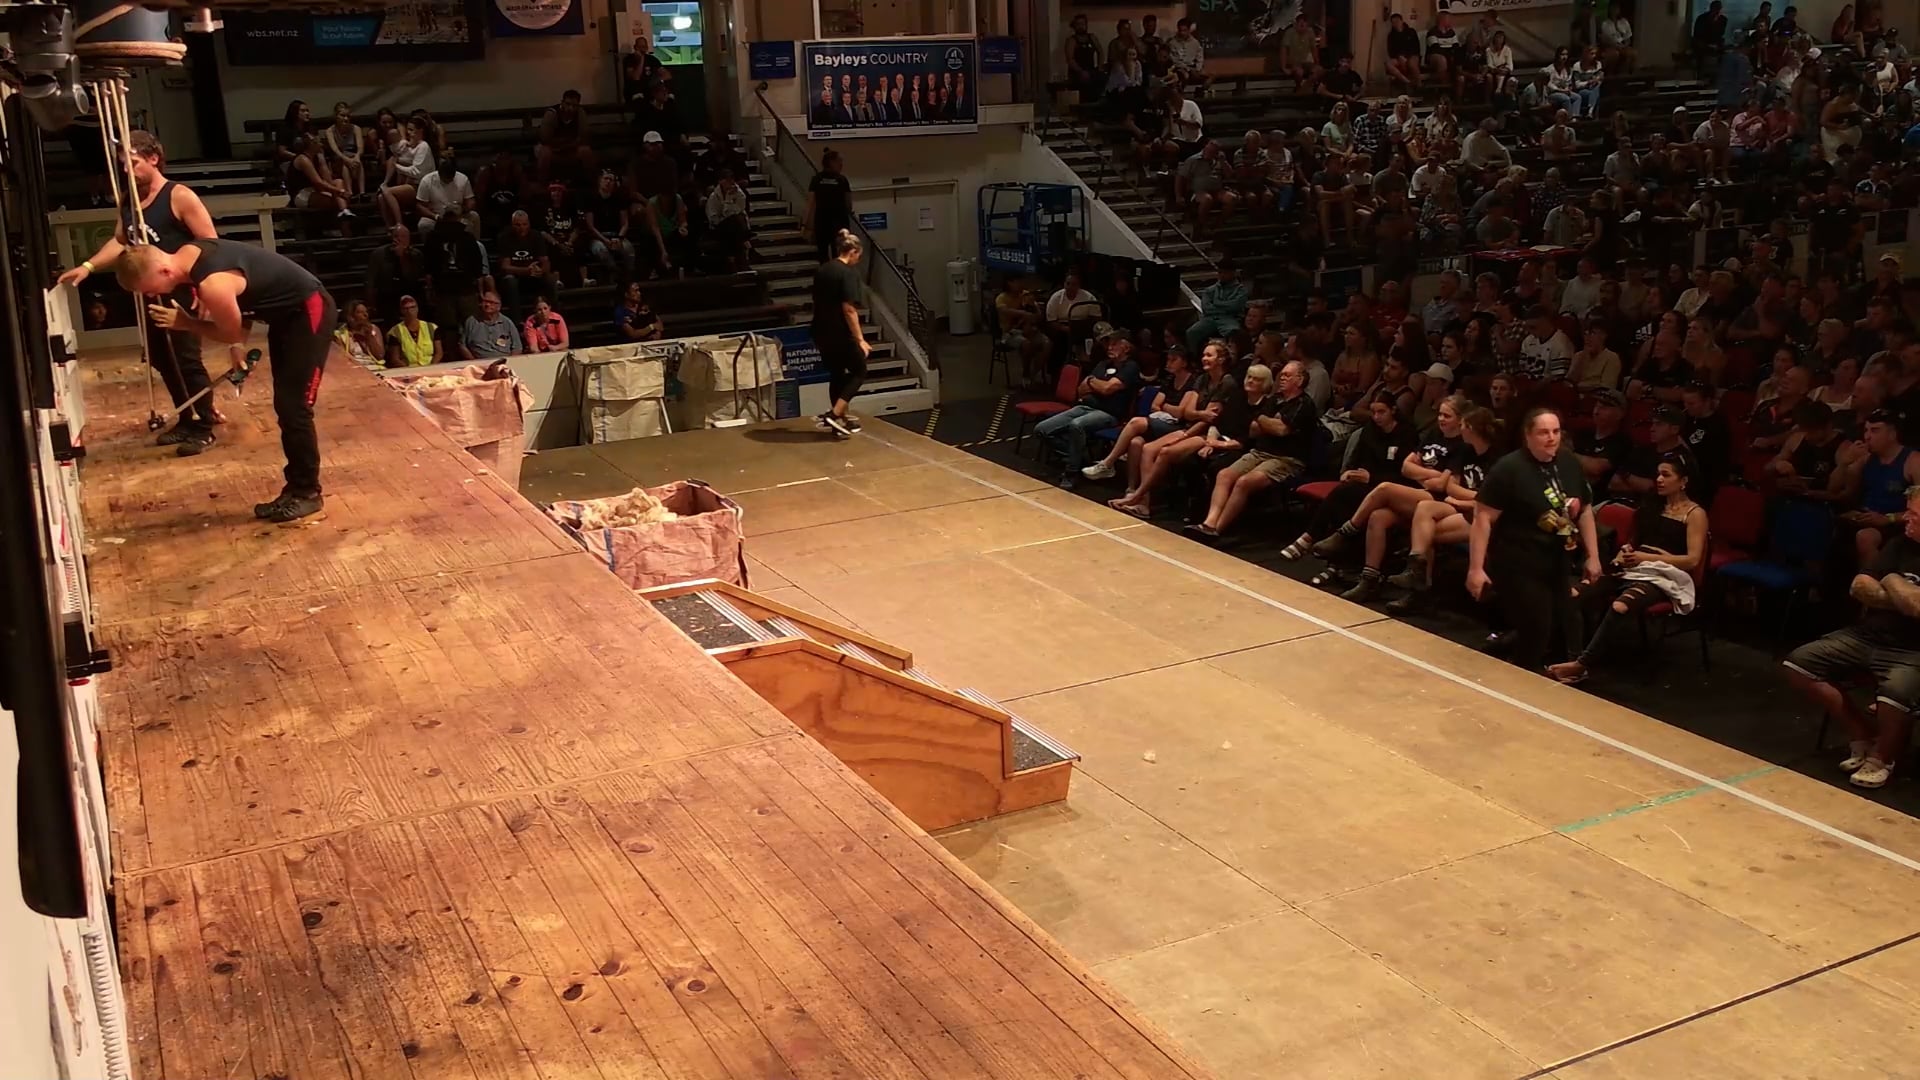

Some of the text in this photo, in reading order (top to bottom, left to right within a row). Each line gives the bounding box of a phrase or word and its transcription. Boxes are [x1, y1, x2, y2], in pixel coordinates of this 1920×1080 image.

[246, 28, 300, 38] wbs.net.nz
[814, 52, 928, 68] Bayleys COUNTRY
[786, 355, 822, 365] SHEARING
